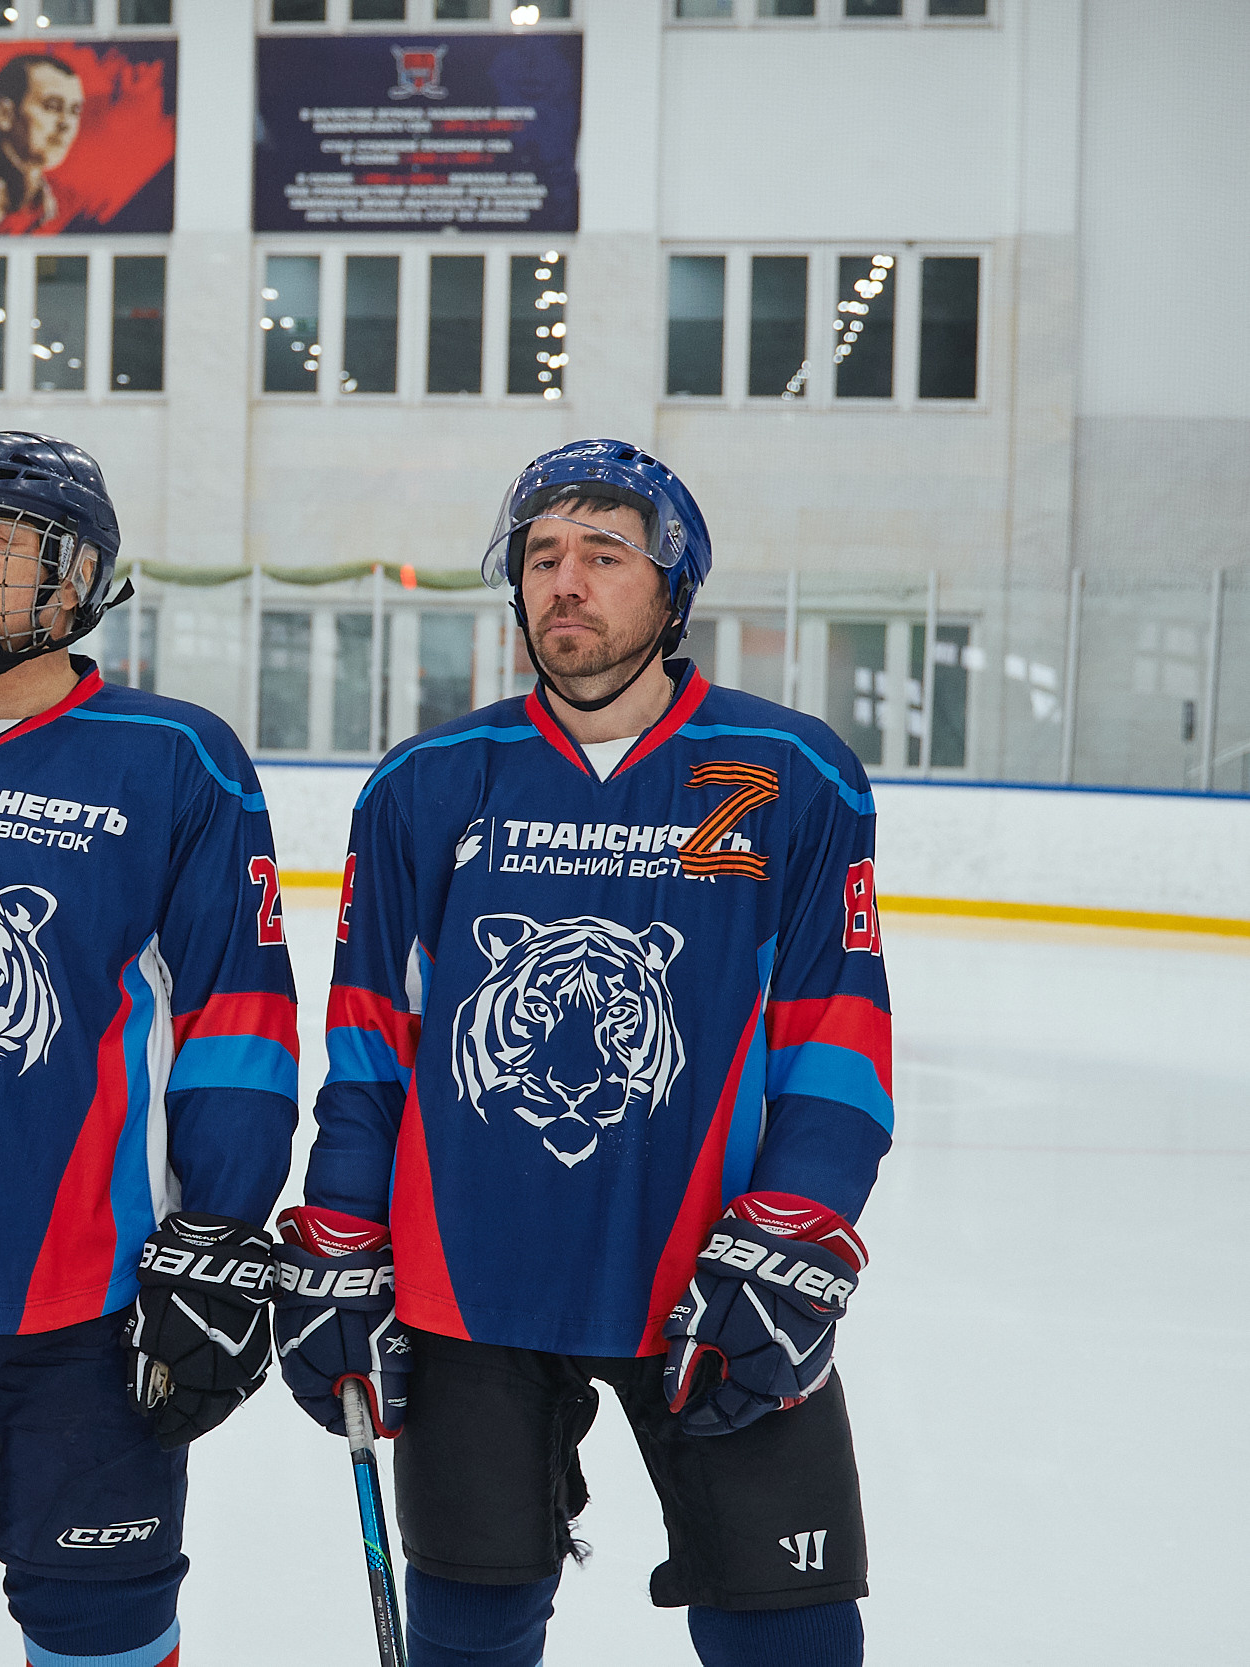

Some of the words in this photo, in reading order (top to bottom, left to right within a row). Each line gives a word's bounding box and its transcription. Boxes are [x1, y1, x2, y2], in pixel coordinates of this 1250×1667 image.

[500, 852, 624, 878] ДАЛЬНИЙ
[628, 857, 716, 884] ВОСТ
[842, 857, 881, 957] 8
[139, 1242, 275, 1291] BAUER
[698, 1233, 855, 1309] BAUER
[68, 1525, 152, 1543] CCM
